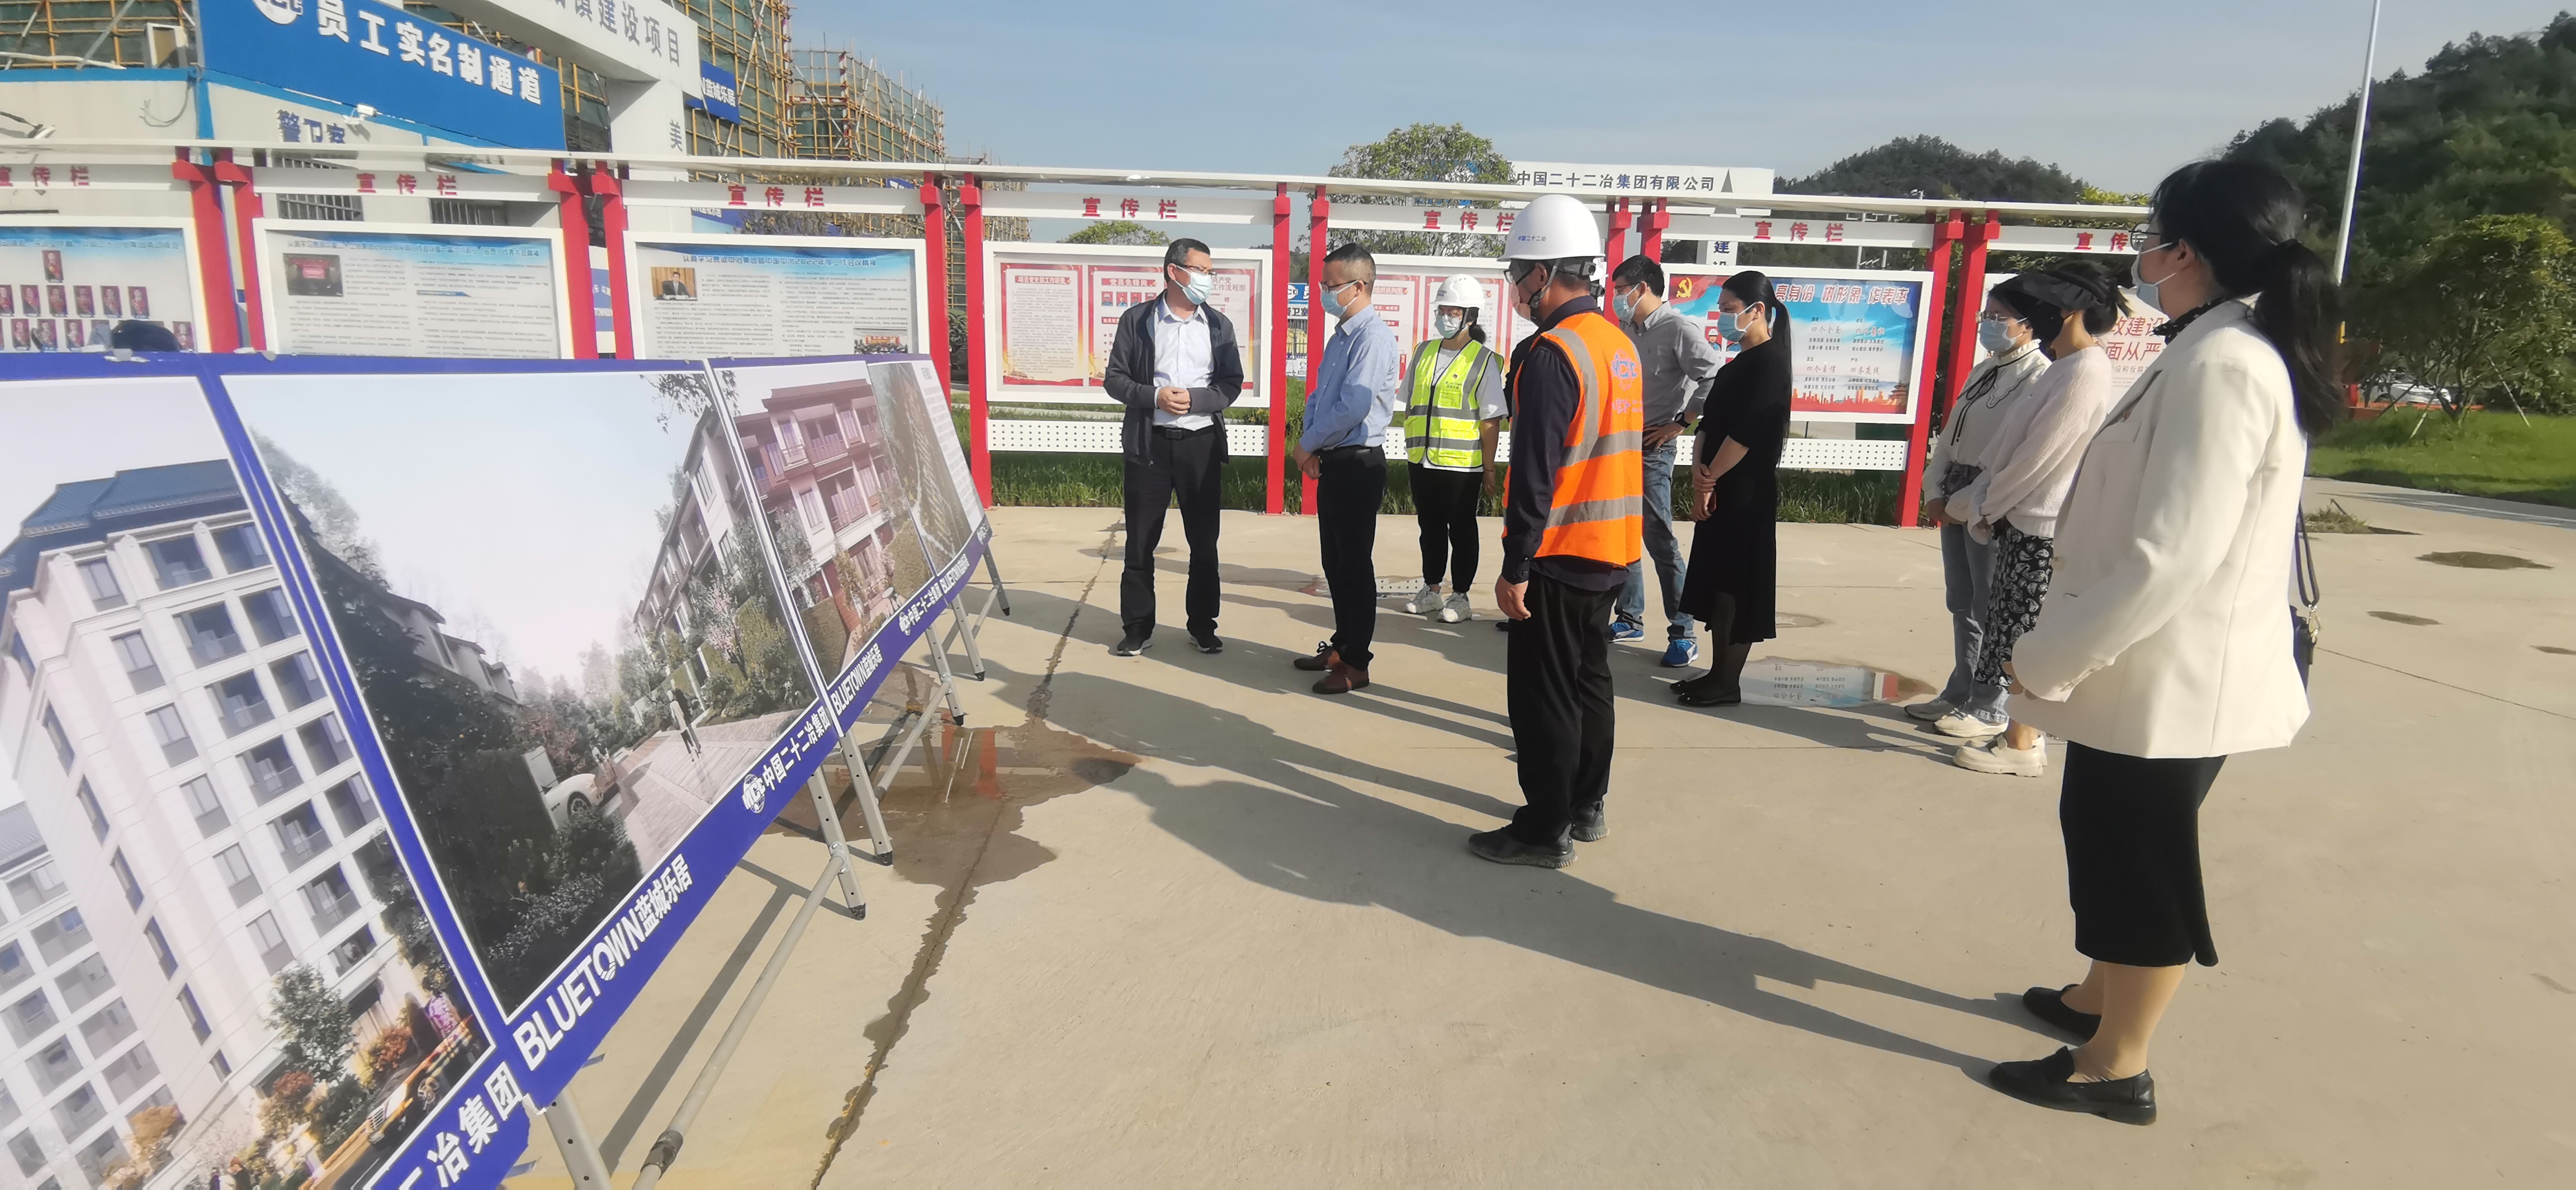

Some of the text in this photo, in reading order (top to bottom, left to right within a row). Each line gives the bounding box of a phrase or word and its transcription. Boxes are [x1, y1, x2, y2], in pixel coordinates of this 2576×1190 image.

[555, 0, 679, 67] 镇建设项目
[316, 0, 542, 105] 员工实名制通道
[278, 109, 346, 144] 警卫室
[669, 119, 683, 152] 美
[357, 173, 458, 196] 宣传栏
[1517, 169, 1714, 191] 中国二十二冶集团有限公司
[728, 184, 825, 207] 宣传栏
[1082, 197, 1178, 219] 宣传栏
[1422, 210, 1516, 233] 宣传栏
[1753, 220, 1844, 243] 宣传栏
[1775, 284, 1910, 304] 亮身份 树形象 作表率
[2106, 342, 2161, 361] 面从严
[1807, 365, 1836, 374] 四个自信
[908, 582, 943, 625] 中国二十二冶集团
[762, 705, 831, 793] 中国二十二冶集团
